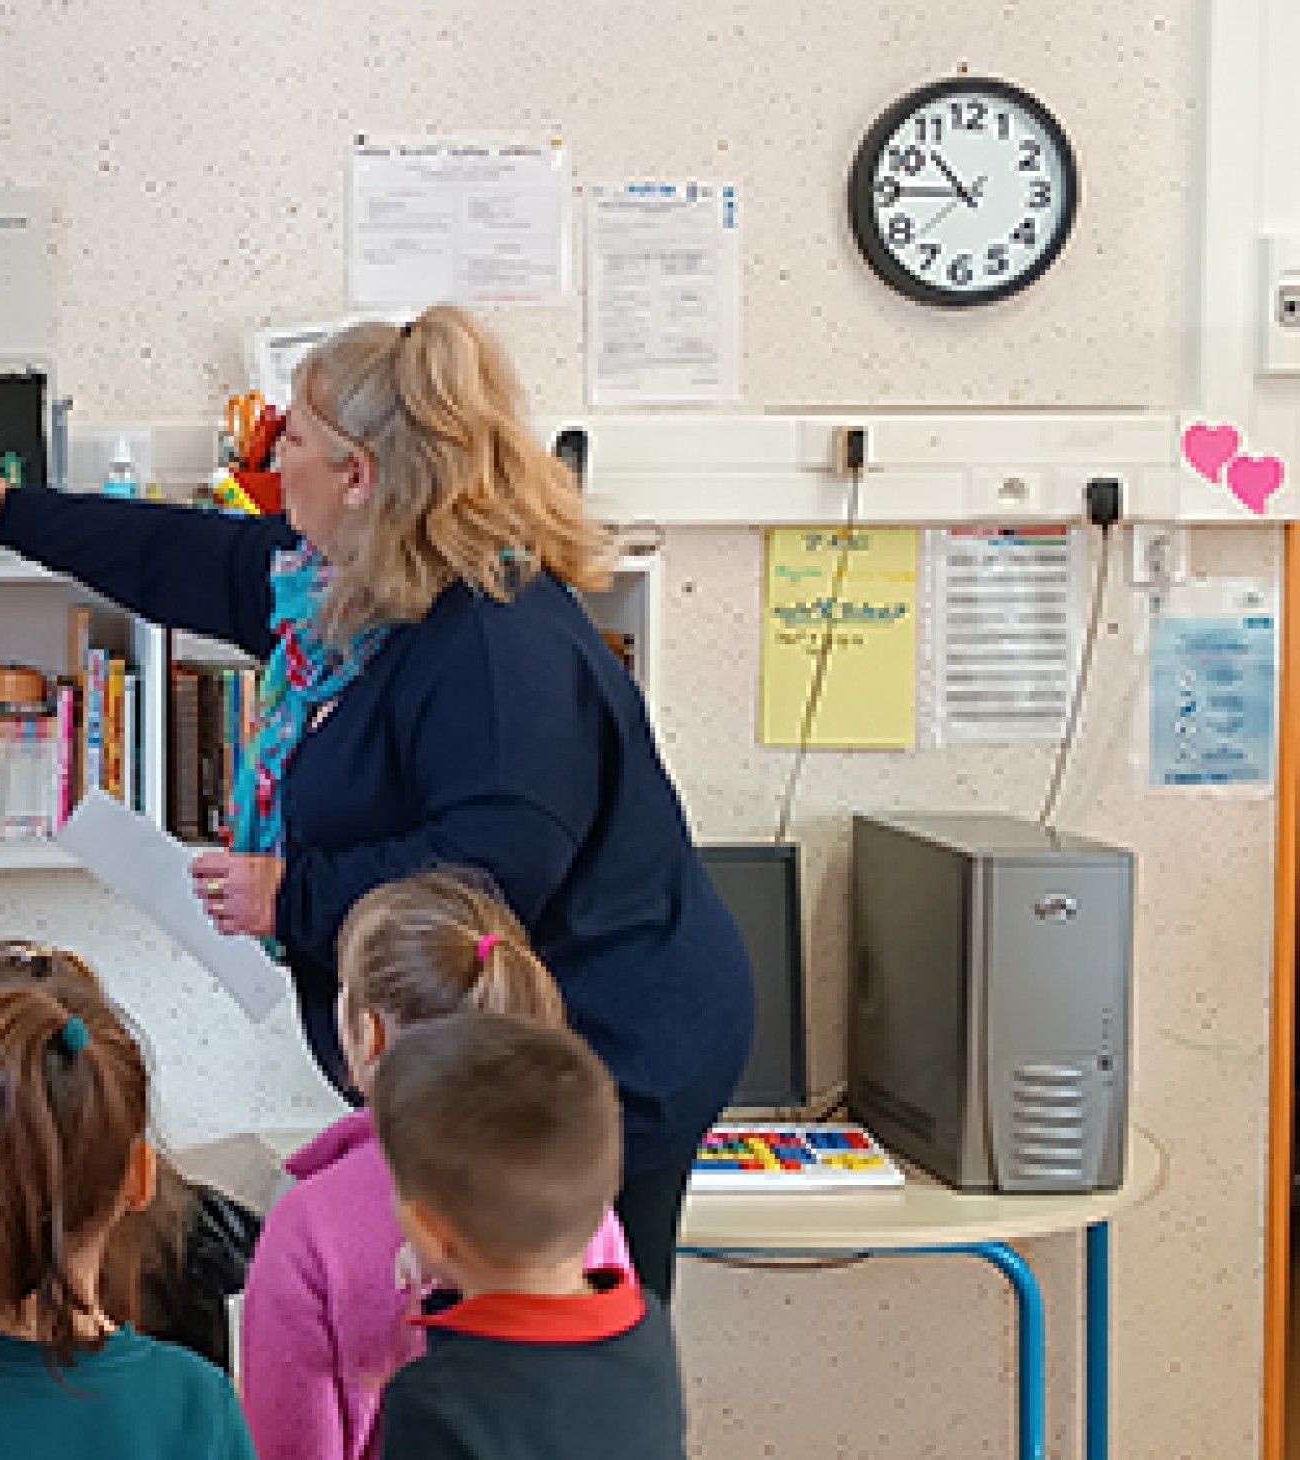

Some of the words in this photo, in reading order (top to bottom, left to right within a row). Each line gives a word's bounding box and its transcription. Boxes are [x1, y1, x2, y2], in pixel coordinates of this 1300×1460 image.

[914, 118, 942, 141] 11
[951, 103, 988, 130] 12
[997, 113, 1010, 140] 1
[889, 147, 926, 176] 10
[1018, 140, 1040, 171] 2
[874, 176, 900, 207] 9
[1029, 181, 1051, 207] 3
[888, 215, 911, 244] 8
[1009, 217, 1035, 244] 4
[919, 243, 941, 270] 7
[948, 254, 973, 285] 6
[984, 245, 1009, 275] 5
